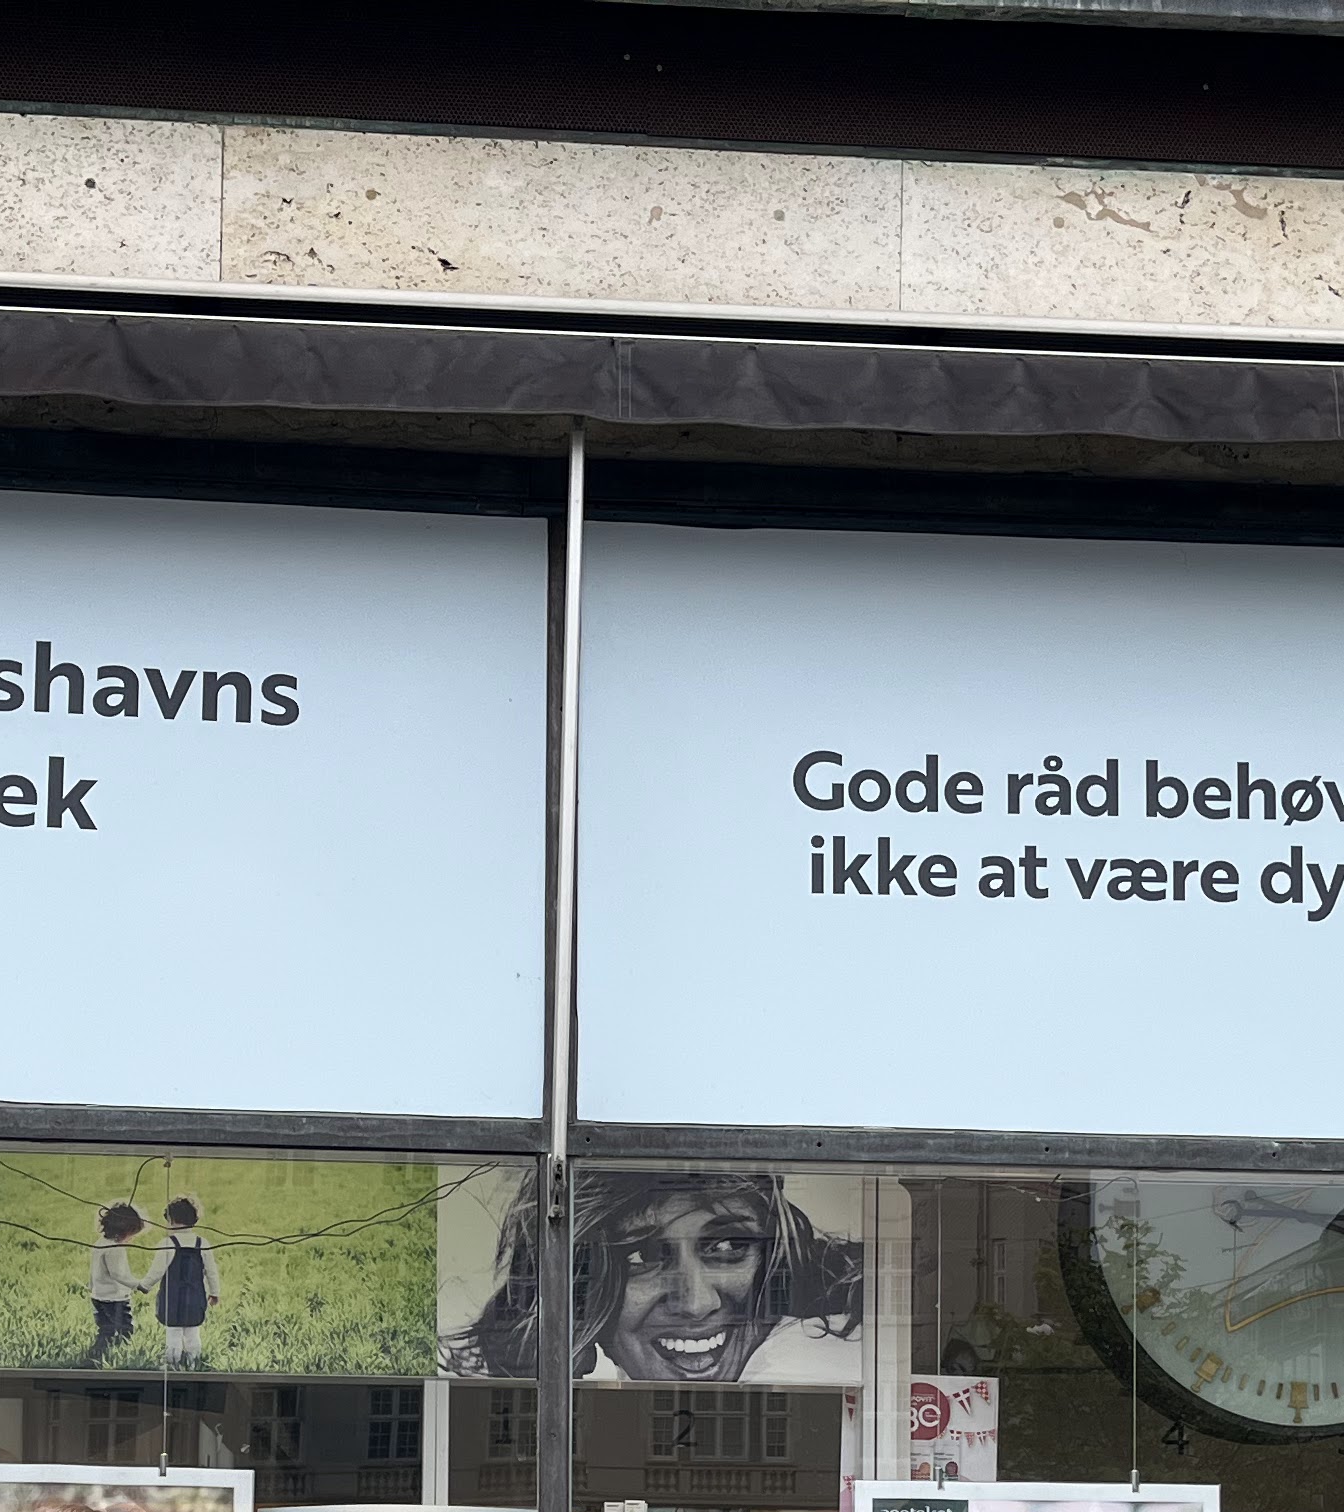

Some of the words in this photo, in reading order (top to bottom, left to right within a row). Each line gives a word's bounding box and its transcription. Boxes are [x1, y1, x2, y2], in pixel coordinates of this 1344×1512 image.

[792, 750, 984, 817] Gode
[1007, 755, 1120, 819] råd
[809, 834, 958, 898] ikke
[978, 844, 1049, 900] at
[1065, 852, 1240, 903] være
